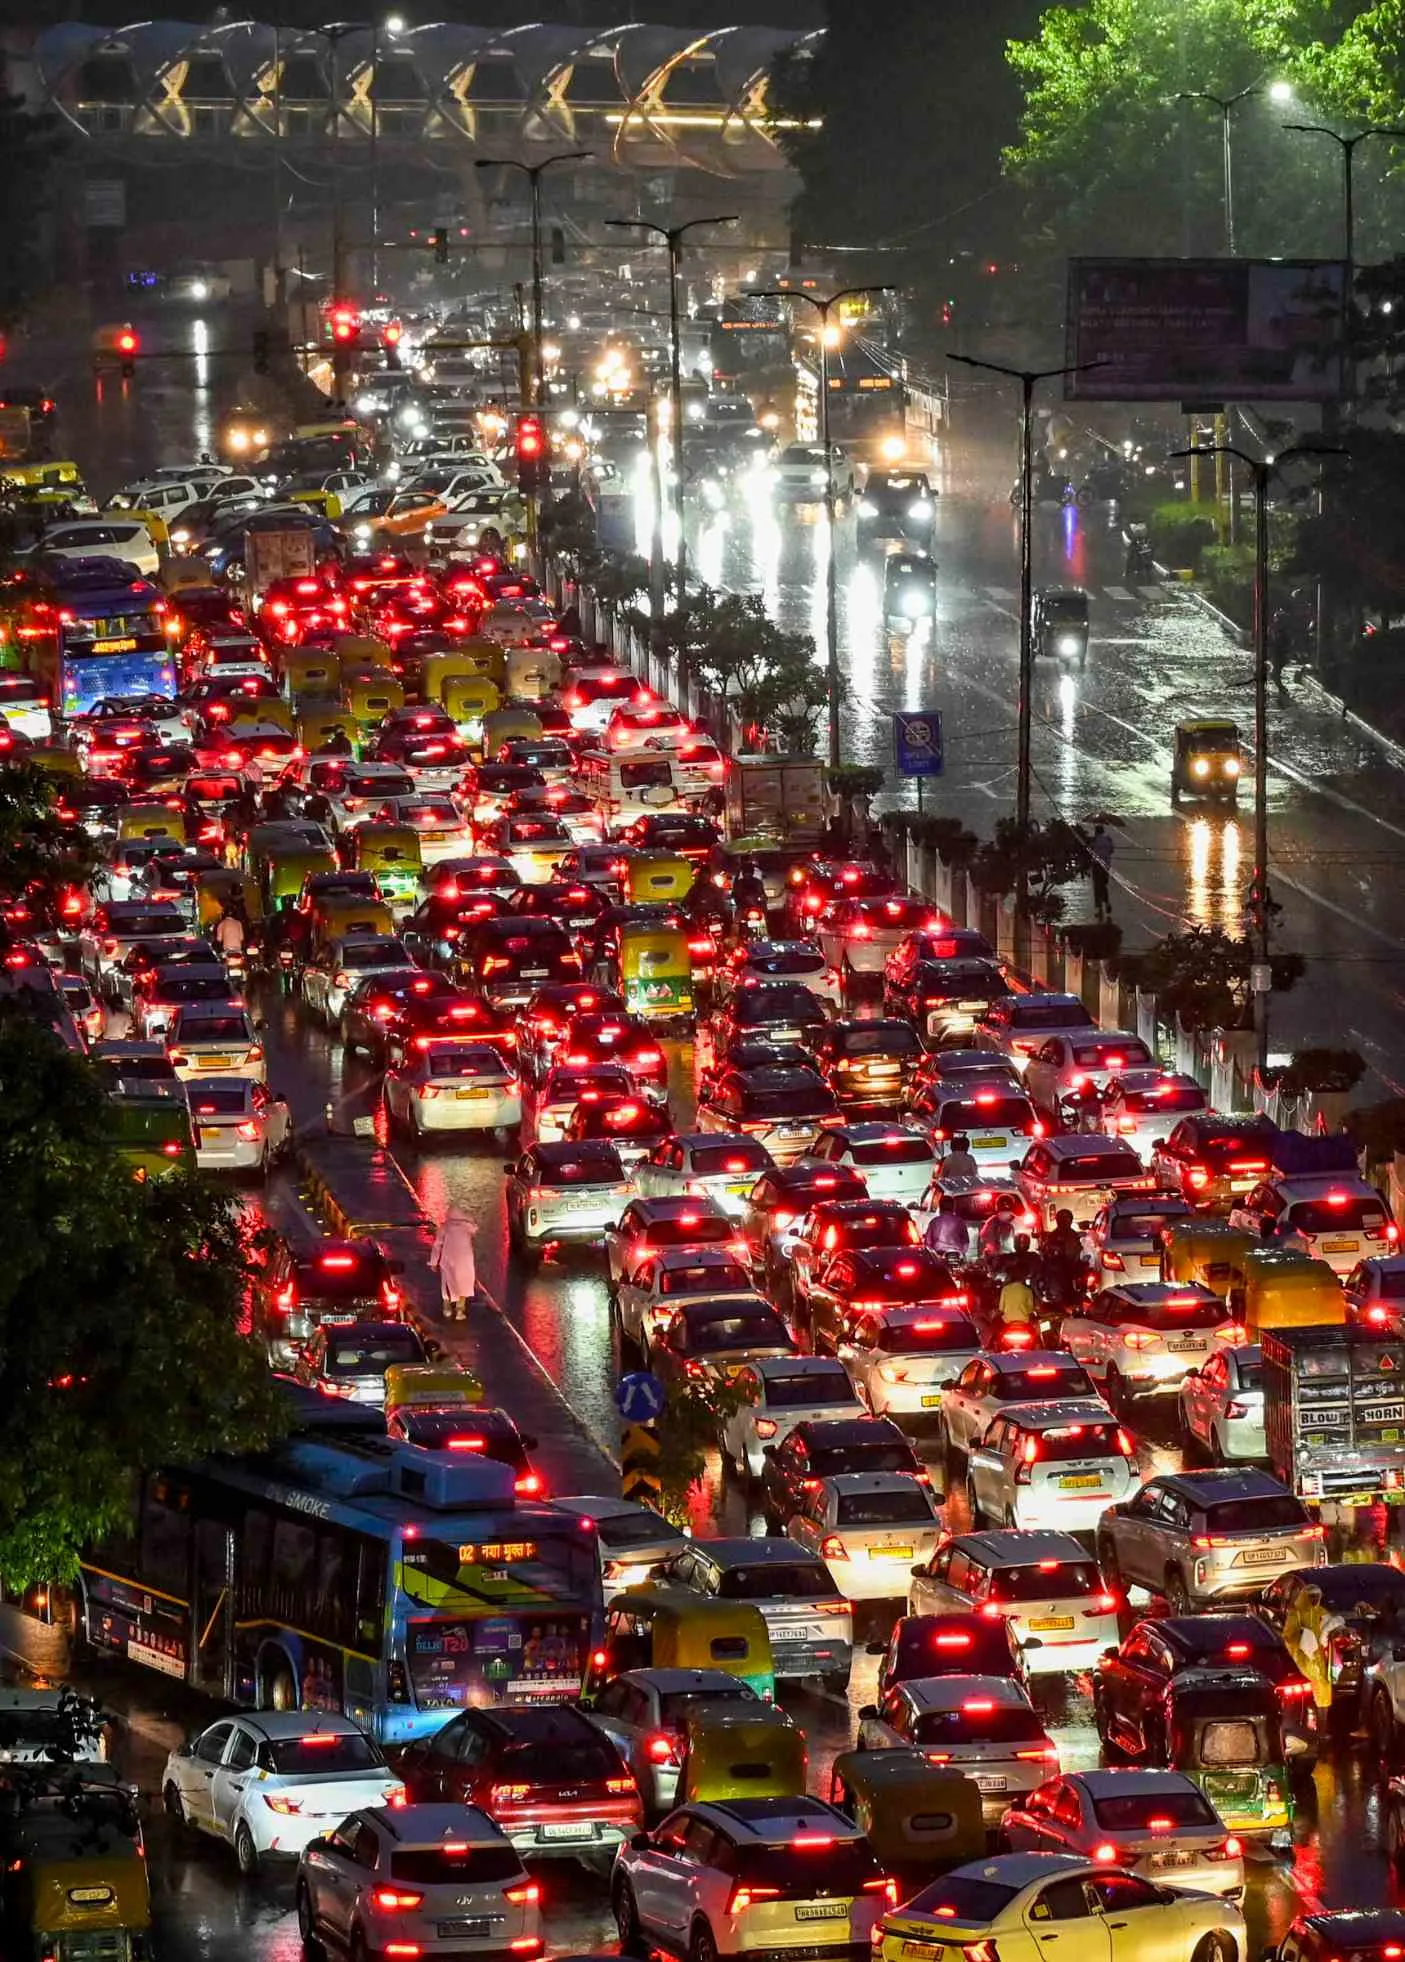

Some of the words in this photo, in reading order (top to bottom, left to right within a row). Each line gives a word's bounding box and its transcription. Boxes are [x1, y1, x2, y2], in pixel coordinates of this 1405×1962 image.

[1301, 1413, 1338, 1425] BLOW
[1366, 1407, 1402, 1420] HORN
[286, 1491, 331, 1519] SMOKE
